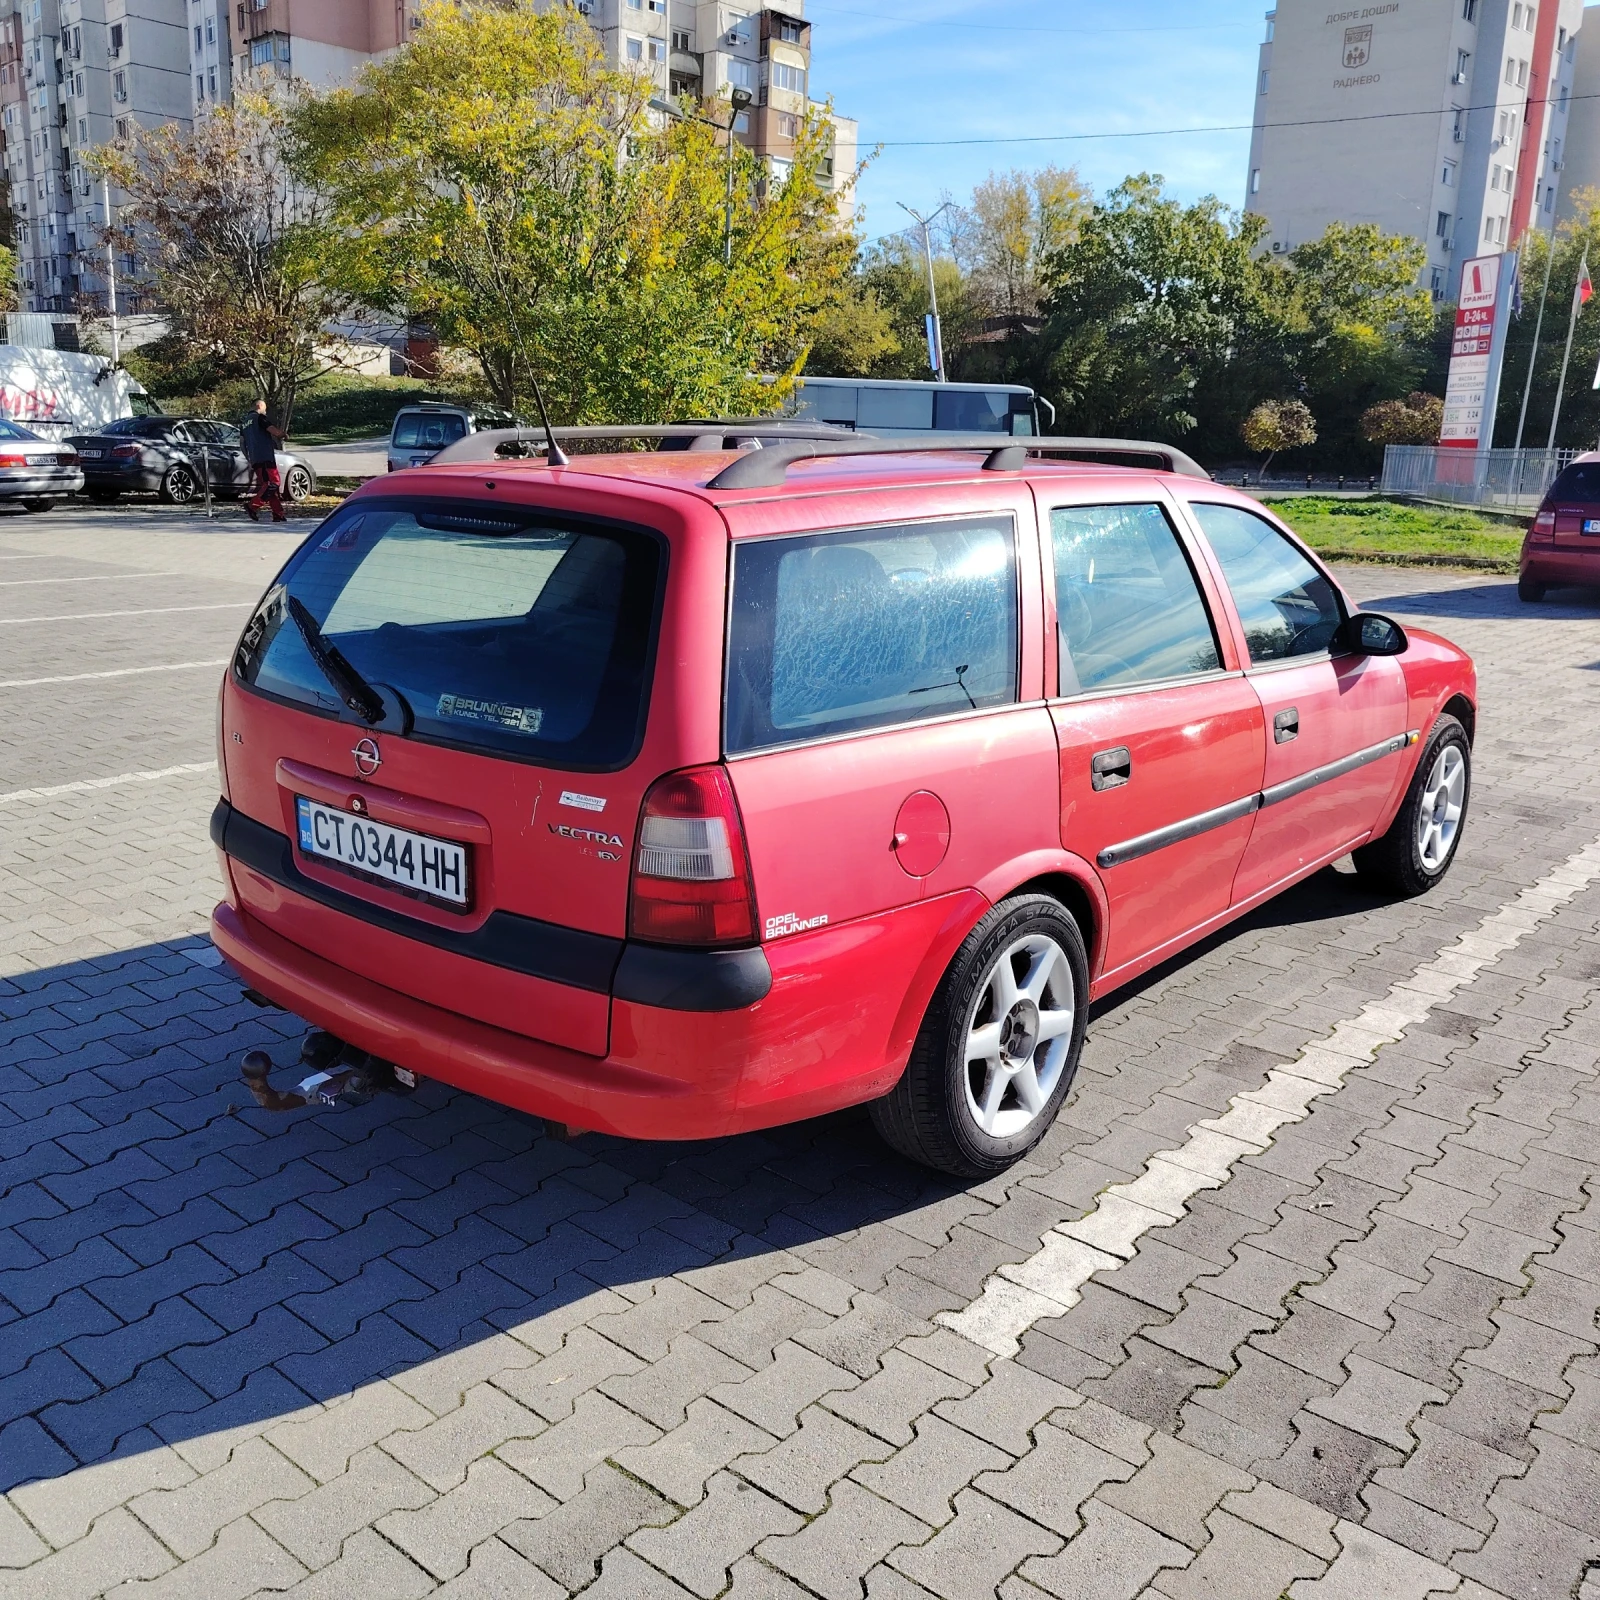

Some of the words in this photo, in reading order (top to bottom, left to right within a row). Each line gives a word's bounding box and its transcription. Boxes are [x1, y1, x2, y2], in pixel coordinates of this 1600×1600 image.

[1325, 10, 1360, 25] ДОБРЕ
[1360, 3, 1399, 19] ДОШЛИ
[1332, 73, 1381, 89] РАДНЕВО
[1463, 294, 1493, 303] ГРАНИТ
[1464, 310, 1481, 323] 0-24
[453, 709, 479, 719] KUNDL
[455, 697, 522, 718] BRUNNER
[301, 829, 313, 843] BG
[547, 823, 624, 848] VECTRA
[765, 914, 829, 940] BRUNNER
[766, 912, 799, 929] OPEL
